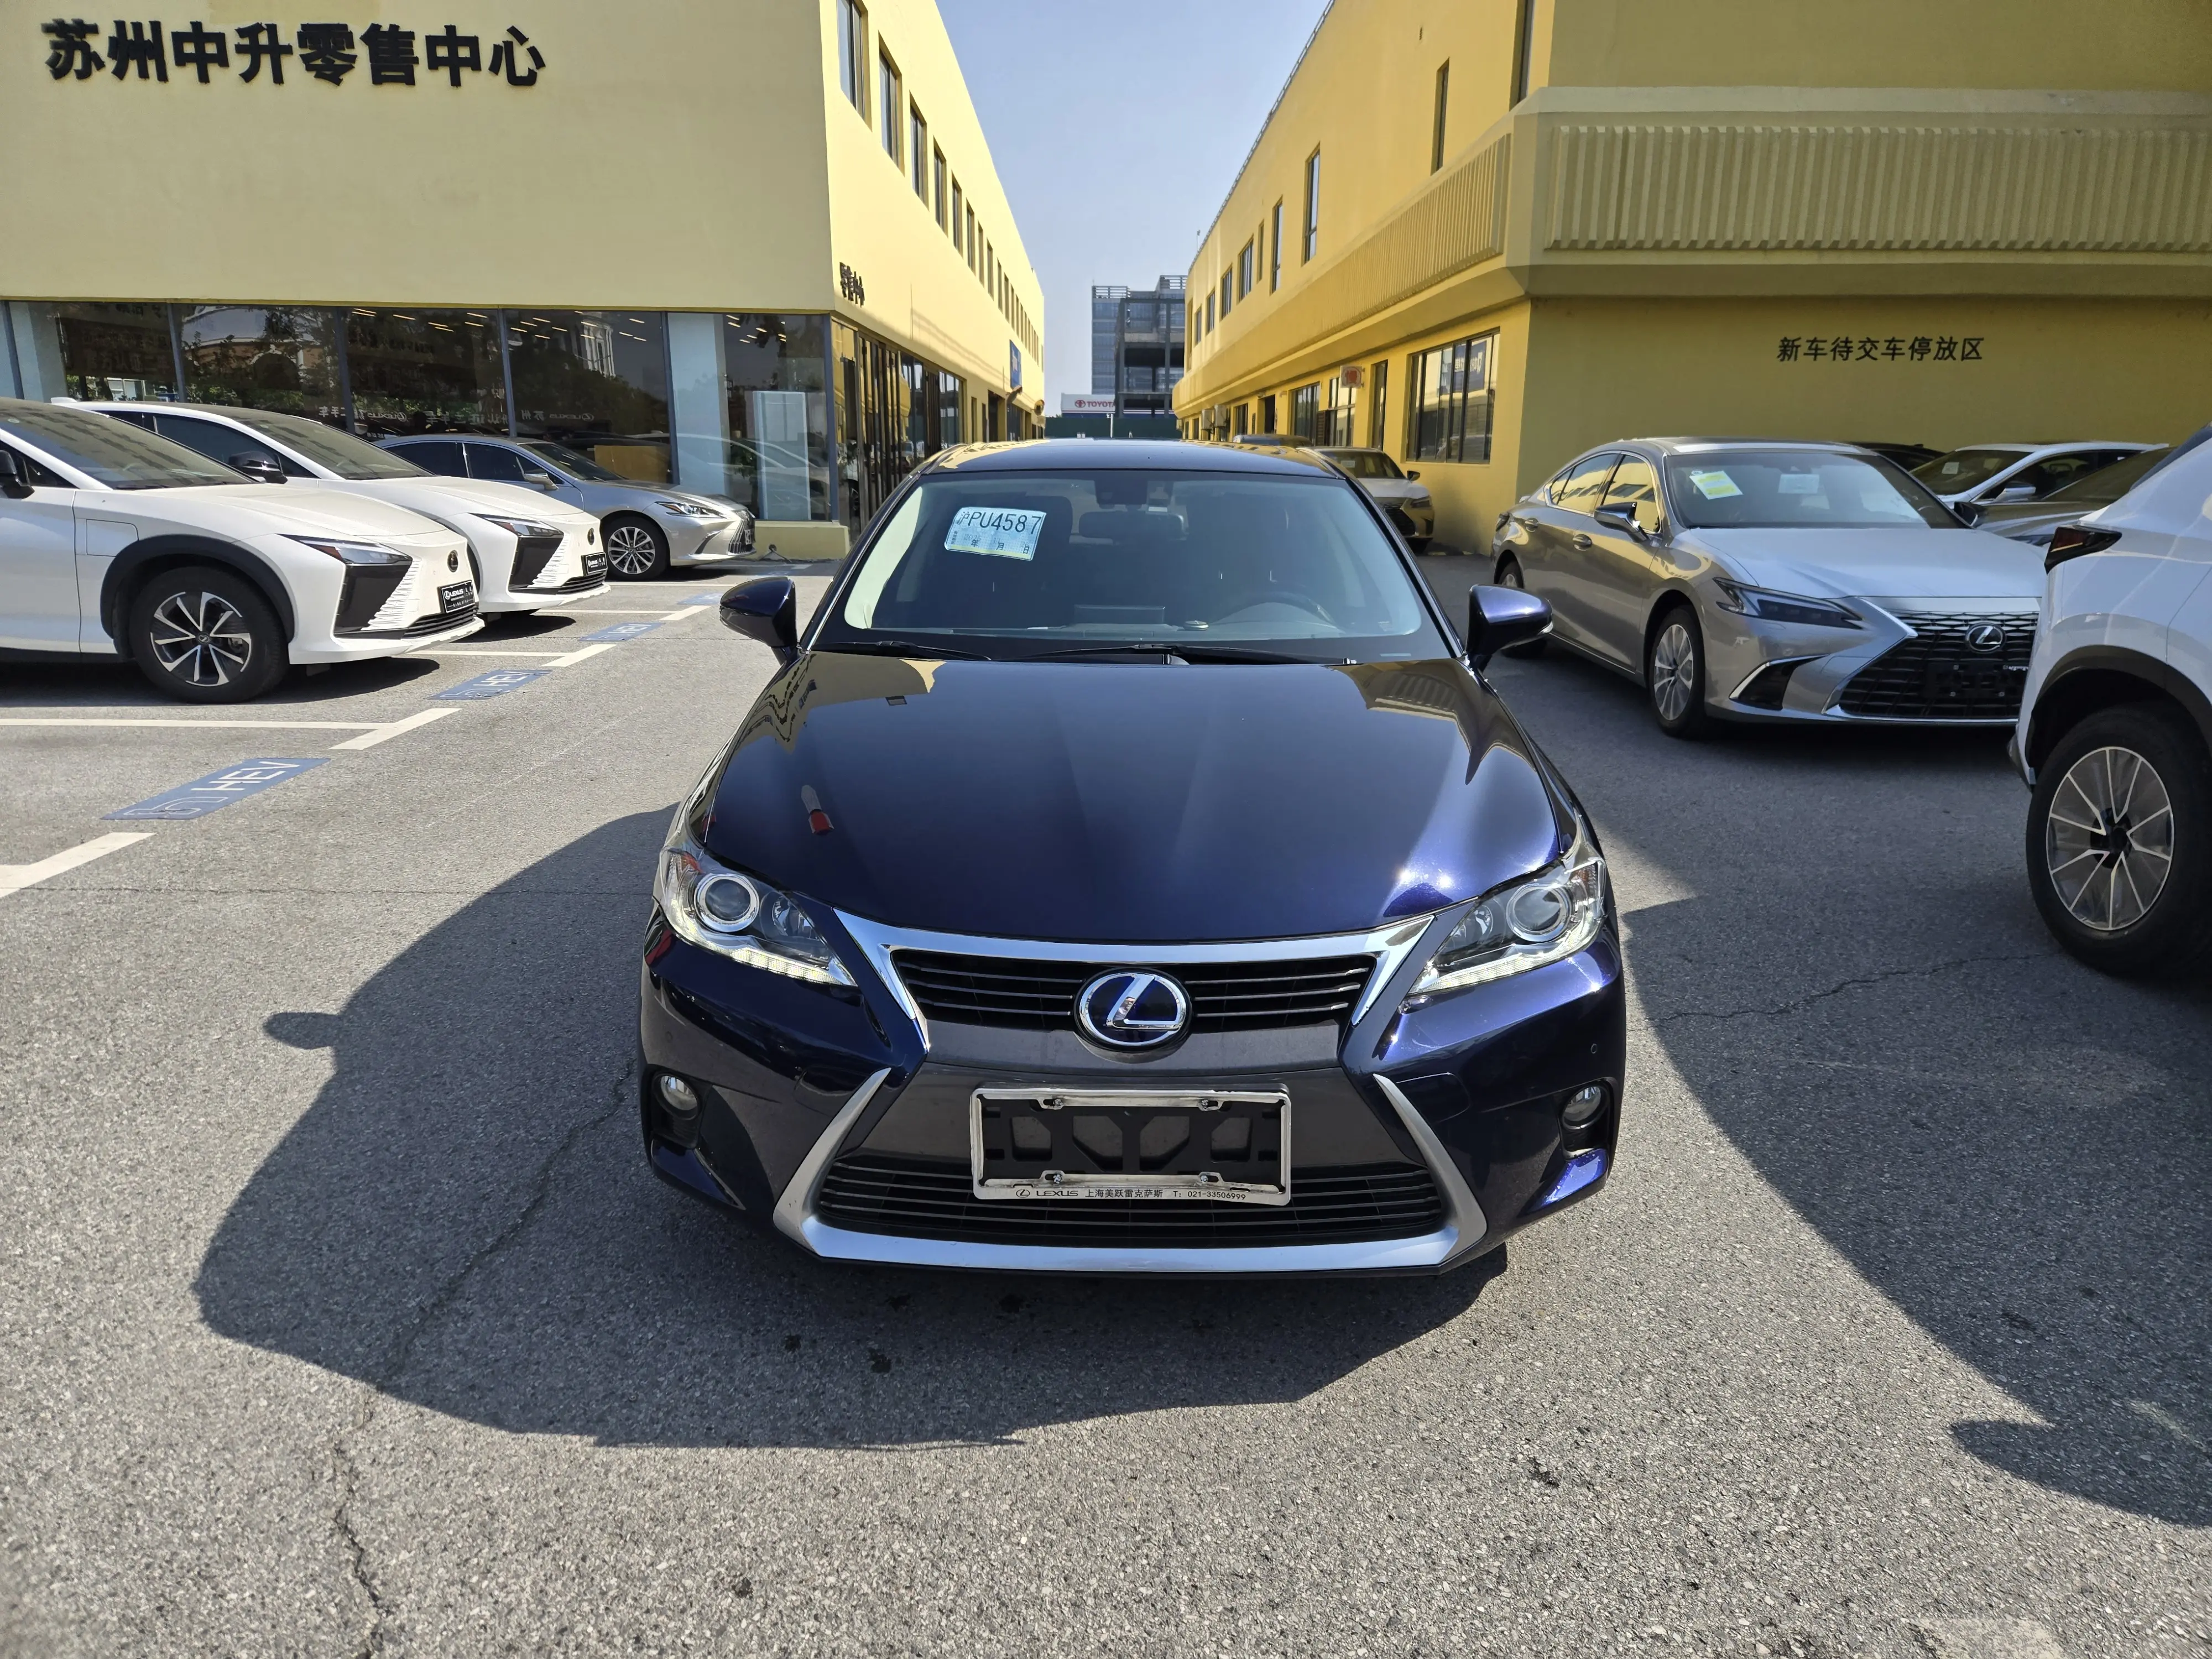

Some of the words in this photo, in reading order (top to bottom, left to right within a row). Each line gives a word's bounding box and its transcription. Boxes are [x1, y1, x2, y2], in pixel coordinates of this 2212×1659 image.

[40, 18, 546, 88] 苏州中升零售中心
[1777, 336, 1984, 361] 新车待交车停放区
[956, 512, 1041, 534] 沪PU4587
[472, 671, 535, 686] HEV
[190, 761, 300, 791] HEV
[1084, 1189, 1163, 1198] 上海美跃雷克萨斯
[1187, 1191, 1246, 1200] 021-33506999
